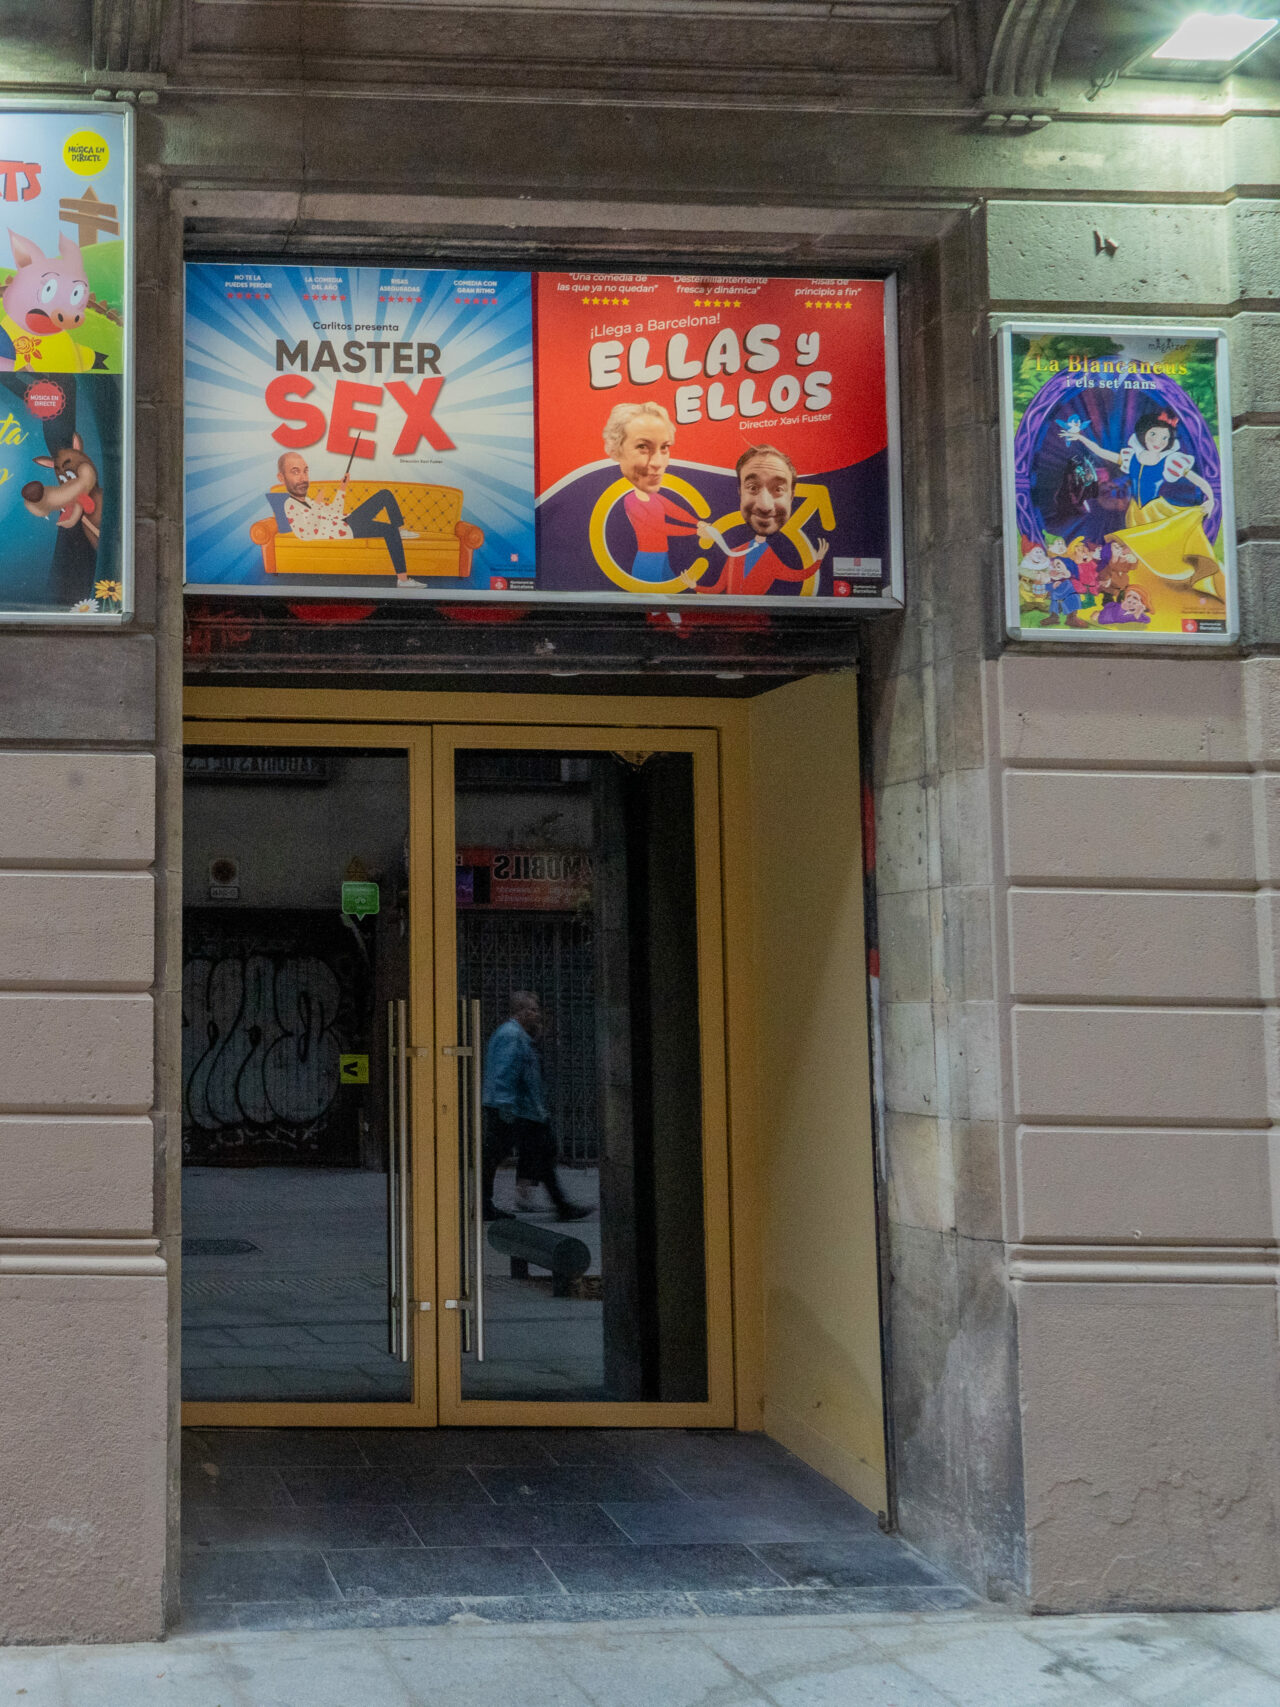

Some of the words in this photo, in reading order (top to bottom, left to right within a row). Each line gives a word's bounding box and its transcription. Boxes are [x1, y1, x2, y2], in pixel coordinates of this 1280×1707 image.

[592, 274, 633, 282] comedia
[557, 284, 570, 292] las
[572, 285, 590, 294] que
[591, 286, 603, 294] ya
[676, 285, 705, 294] fresca
[706, 287, 711, 295] y
[794, 288, 835, 297] principio
[313, 321, 352, 331] Carlitos
[354, 323, 399, 333] presenta
[590, 325, 631, 339] ¡Llega
[635, 324, 643, 332] a
[647, 313, 720, 331] Barcelona!
[275, 339, 442, 375] MASTER
[589, 323, 781, 390] ELLAS
[796, 331, 820, 366] y
[1035, 354, 1060, 372] La
[1068, 354, 1188, 376] Blancaneus
[1066, 376, 1070, 387] i
[1075, 376, 1094, 388] els
[1099, 378, 1120, 389] set
[1124, 380, 1157, 390] nans
[674, 370, 833, 425] ELLOS
[264, 373, 458, 461] SEX
[739, 418, 778, 430] Director
[780, 415, 800, 427] Xavi
[802, 412, 832, 423] Fuster
